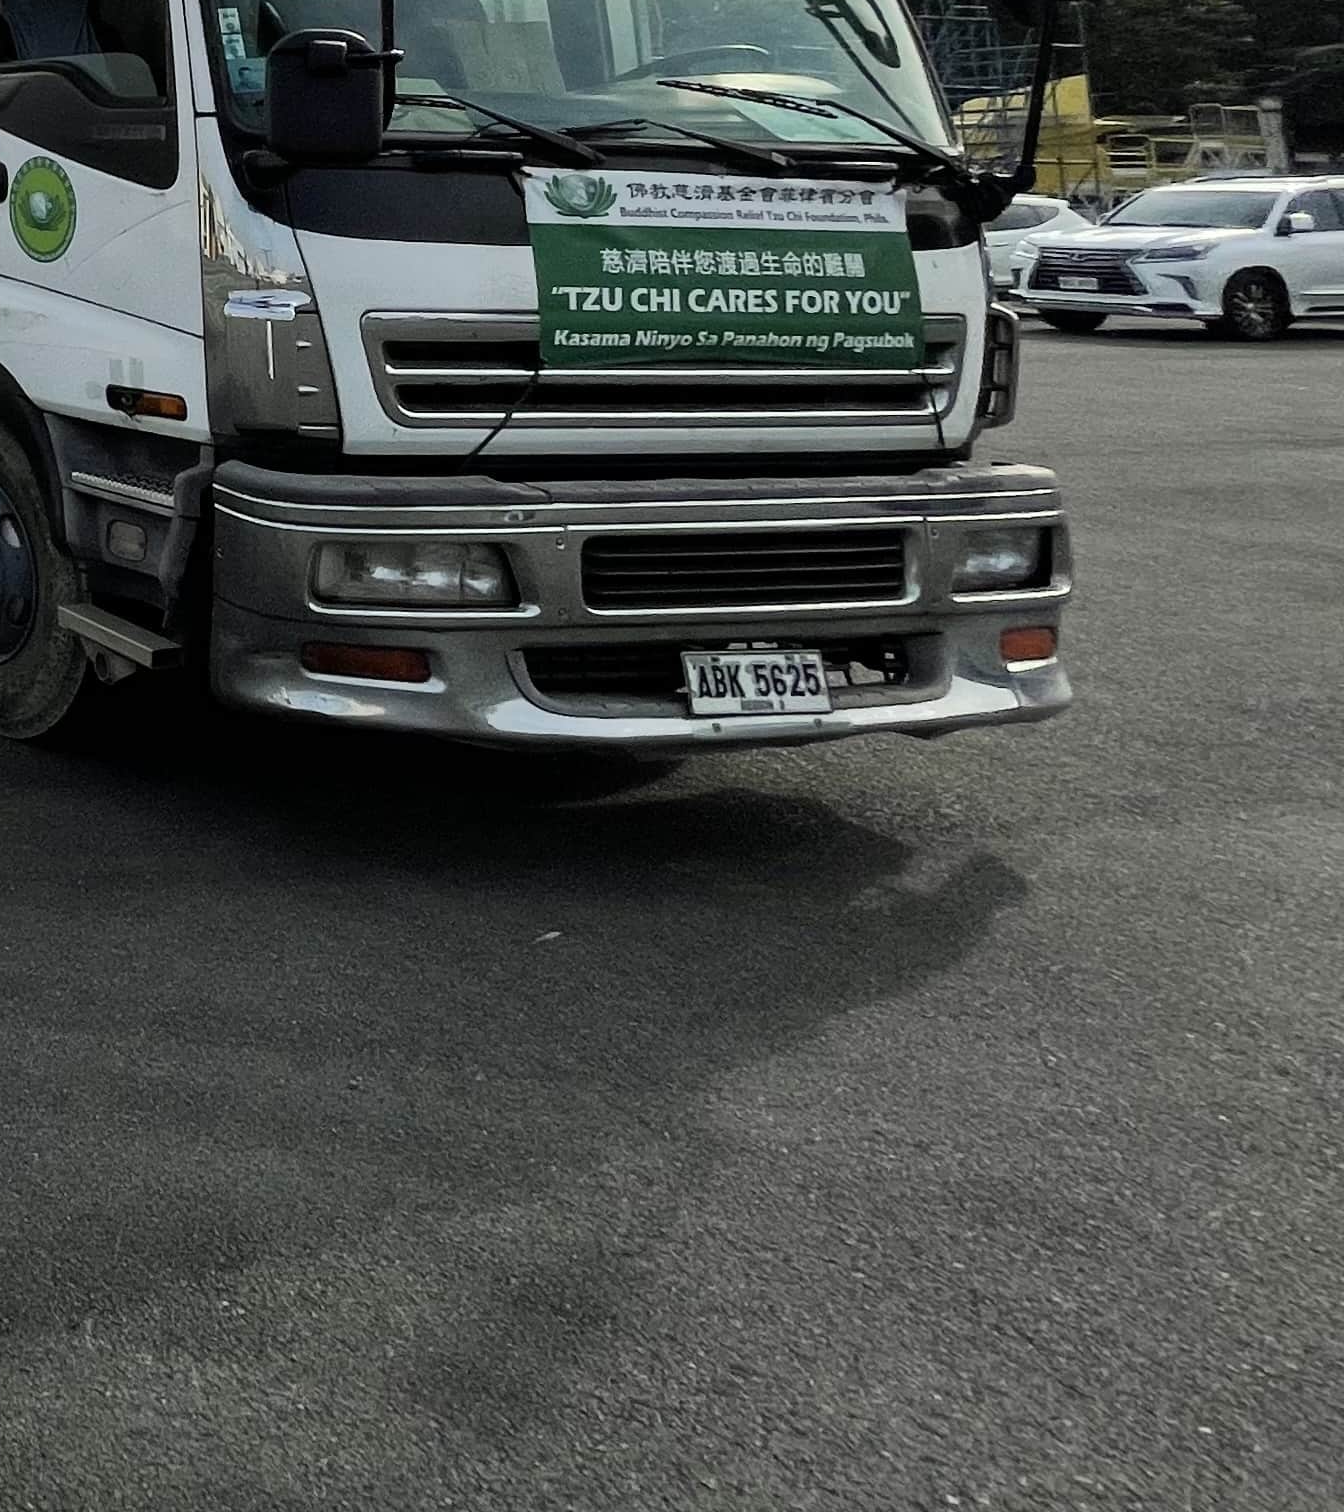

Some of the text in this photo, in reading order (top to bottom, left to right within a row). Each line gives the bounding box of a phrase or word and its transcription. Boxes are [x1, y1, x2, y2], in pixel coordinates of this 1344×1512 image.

[630, 288, 681, 312] CHI
[687, 288, 779, 313] CARES
[785, 290, 840, 314] FOR
[553, 329, 915, 352] Kasama Ninyo Sa Panahon ng Pagsubok
[697, 663, 822, 698] ABK 5625
